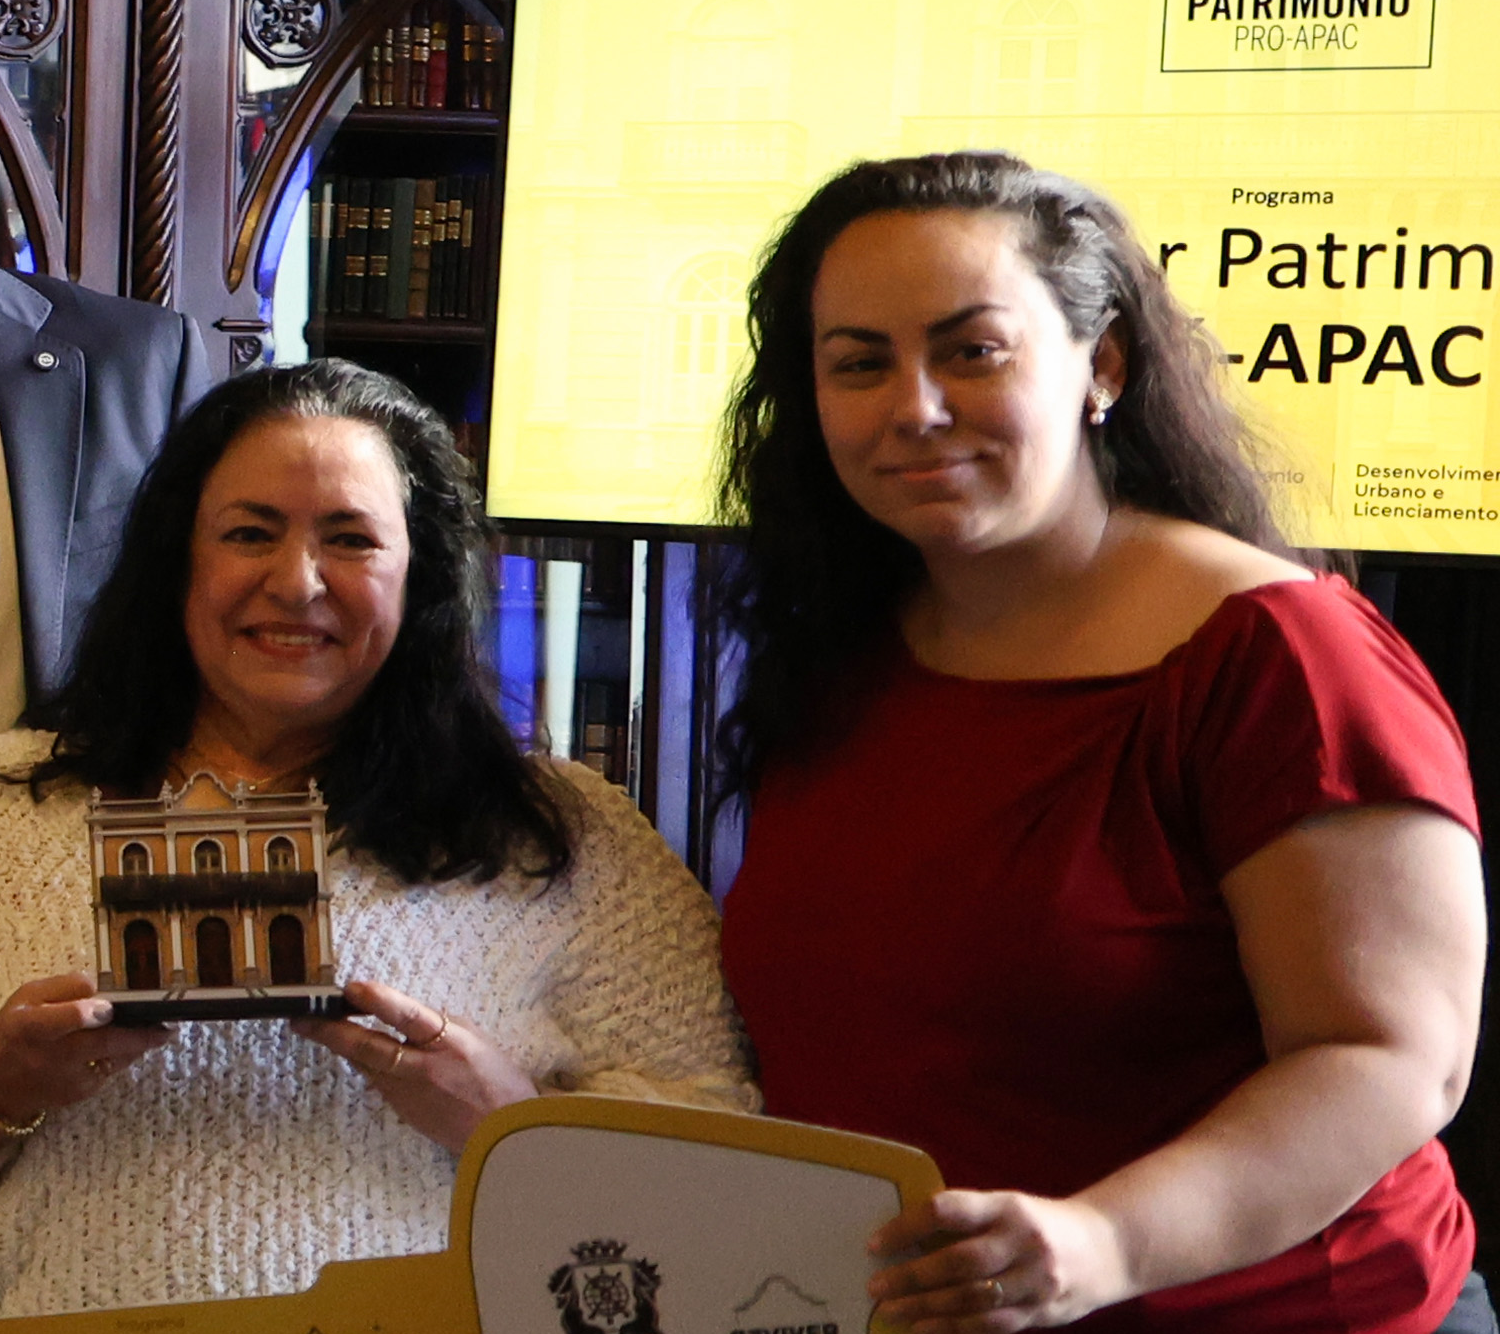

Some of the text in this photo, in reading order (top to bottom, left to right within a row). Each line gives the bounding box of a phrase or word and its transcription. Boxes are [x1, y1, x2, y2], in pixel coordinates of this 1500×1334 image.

[1234, 23, 1359, 51] PRO-APAC
[1231, 187, 1334, 208] Programa
[1218, 227, 1494, 290] Patrim
[1355, 483, 1445, 500] Urbano e
[1353, 502, 1499, 521] Licenciamento
